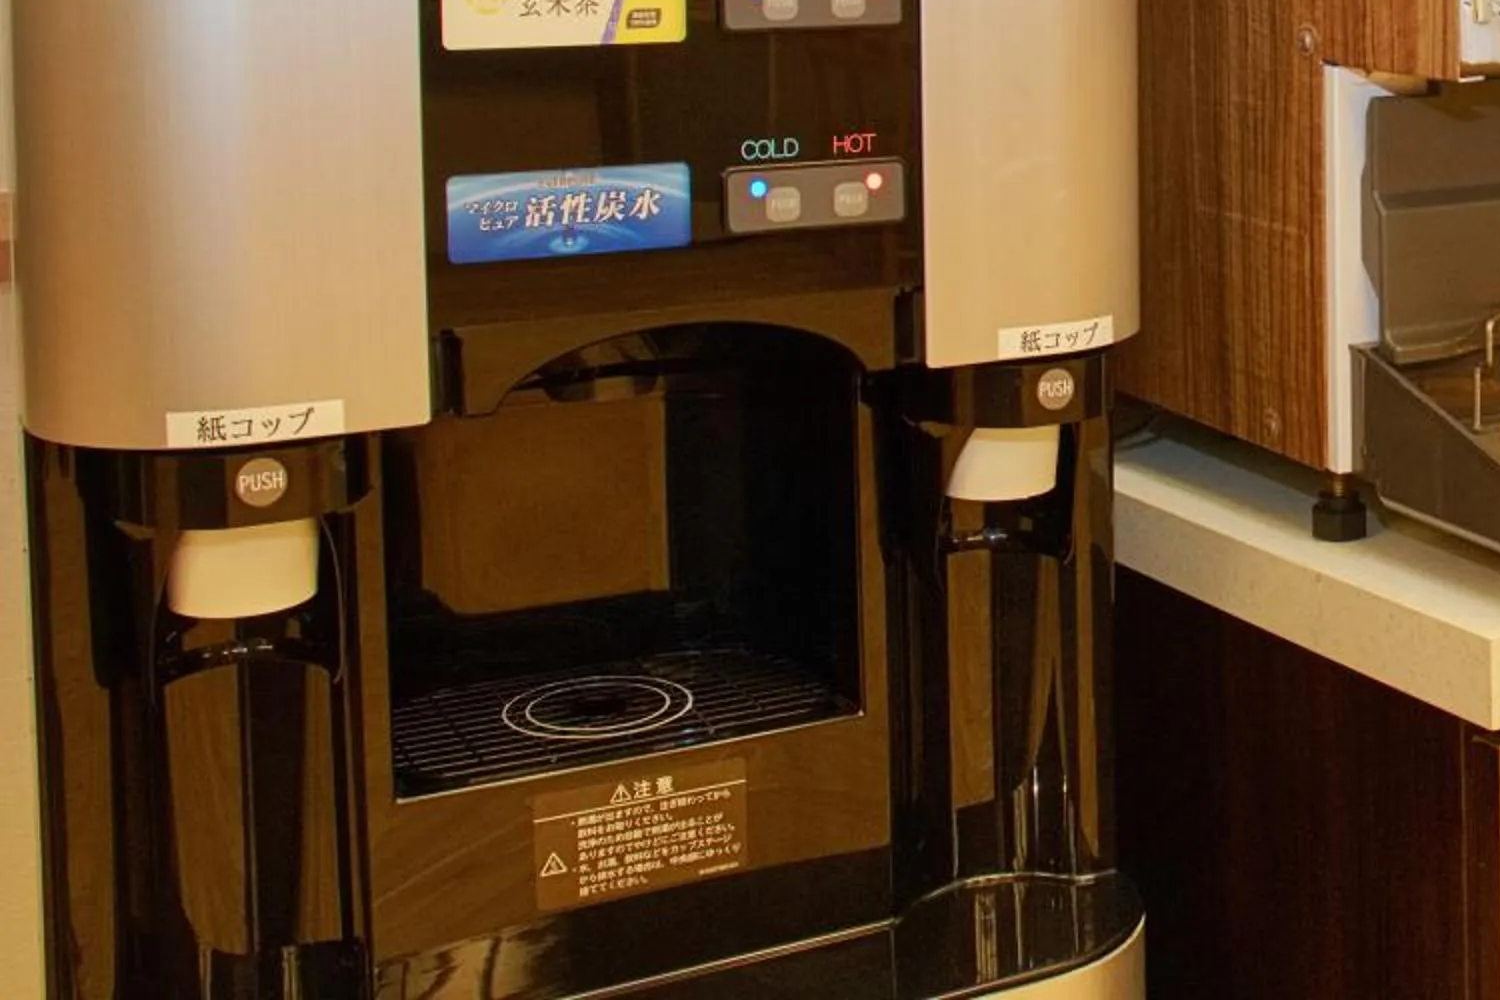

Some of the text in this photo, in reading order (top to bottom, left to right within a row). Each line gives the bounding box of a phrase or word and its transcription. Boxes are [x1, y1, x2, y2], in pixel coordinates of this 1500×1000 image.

[740, 132, 877, 161] COLD HOT
[524, 188, 662, 229] 活性炭水
[1020, 322, 1099, 353] 紙コップ
[1038, 376, 1073, 398] PUSH
[196, 406, 316, 443] 紙コップ
[237, 471, 285, 493] PUSH
